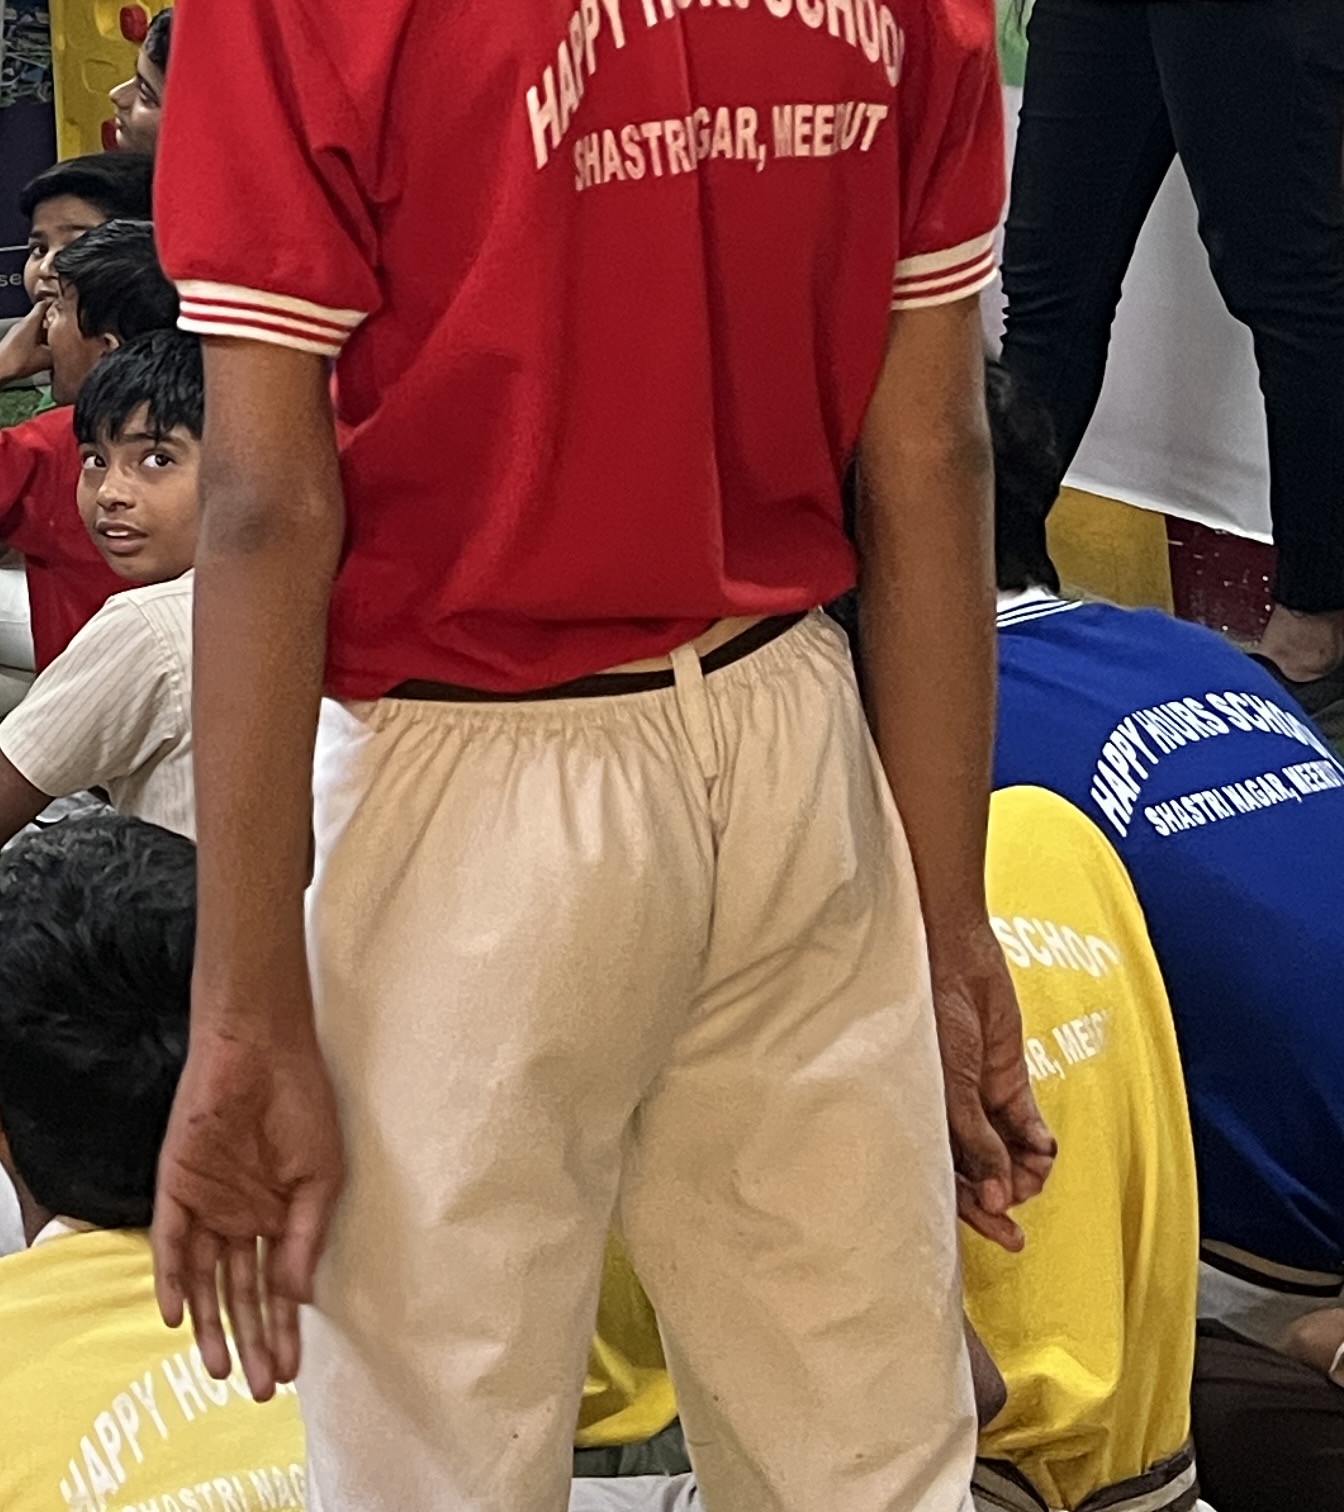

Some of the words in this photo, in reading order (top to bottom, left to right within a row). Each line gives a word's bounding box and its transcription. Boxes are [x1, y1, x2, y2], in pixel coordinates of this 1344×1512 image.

[693, 105, 767, 173] GAR,
[771, 101, 889, 159] MEEUT
[1090, 716, 1160, 838] HAPPY
[1130, 697, 1230, 755] HOURS
[1143, 788, 1236, 837] SHASTRI
[1220, 772, 1303, 814] NAGAR,
[989, 916, 1121, 978] SCHOO
[59, 1371, 169, 1512] HAPPY
